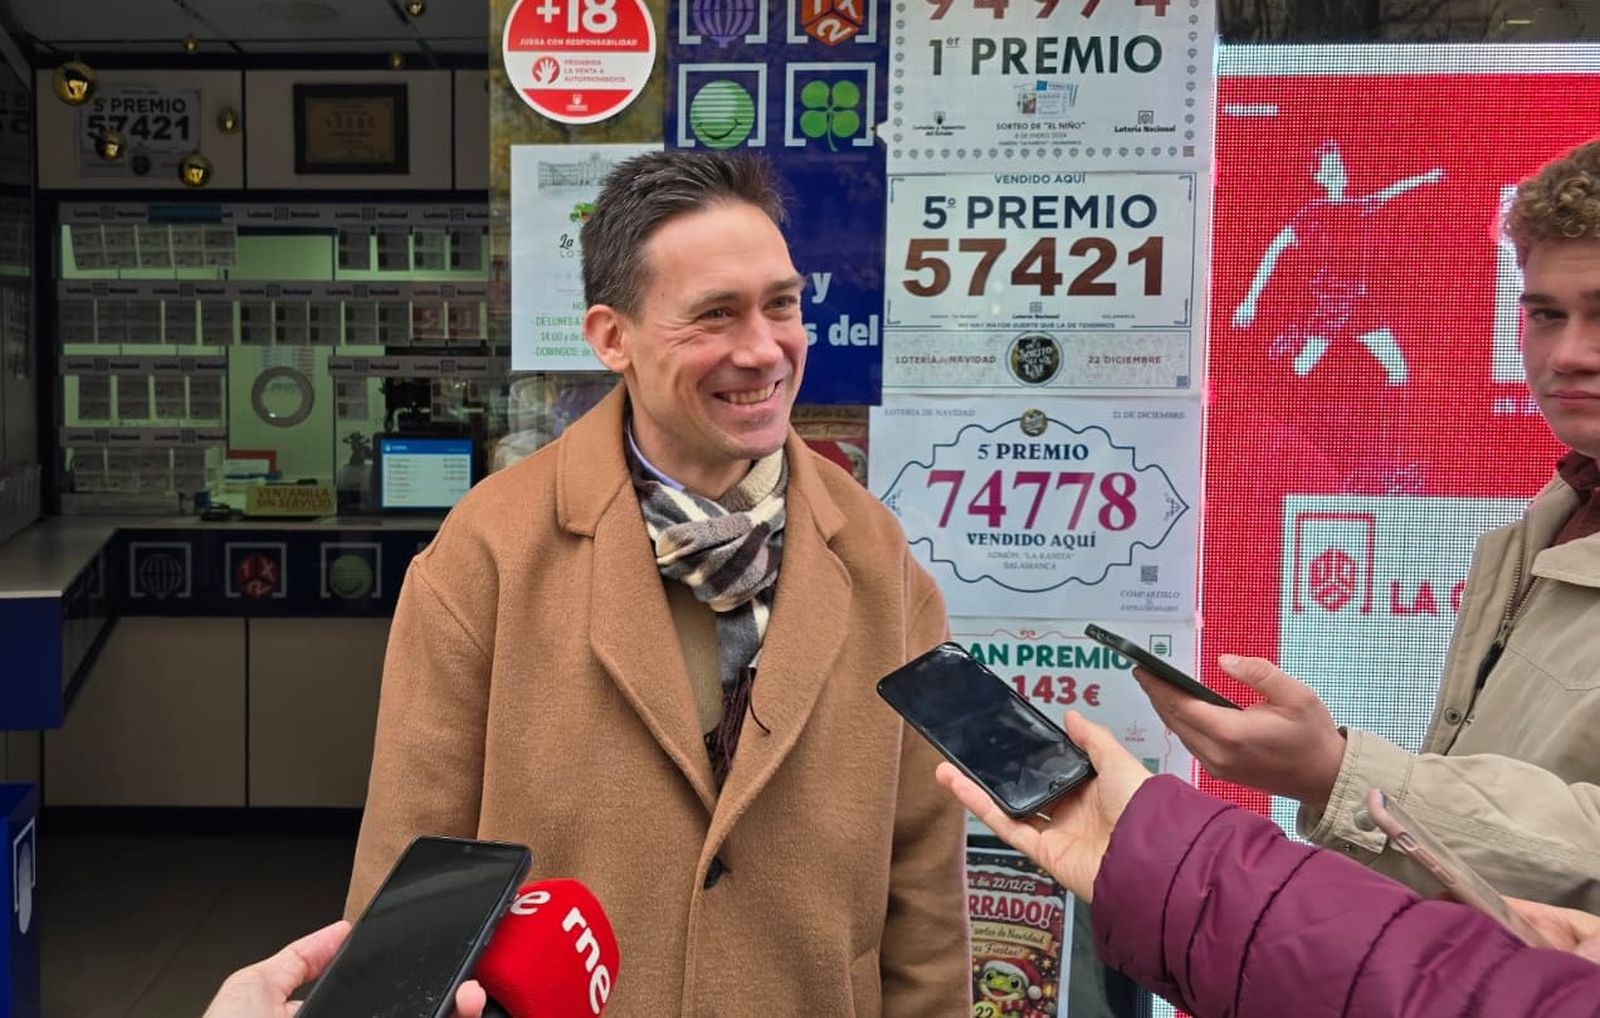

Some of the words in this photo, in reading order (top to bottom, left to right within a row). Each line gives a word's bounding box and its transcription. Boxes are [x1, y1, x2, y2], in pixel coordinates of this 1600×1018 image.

[536, 0, 619, 34] +18
[546, 38, 565, 46] CON
[971, 34, 1163, 76] PREMIO
[111, 98, 187, 114] PREMIO
[996, 122, 1029, 131] SORTEO
[995, 174, 1051, 184] VENDIDO
[1054, 172, 1087, 184] AQUÍ
[966, 194, 1158, 230] PREMIO
[559, 233, 574, 250] La
[902, 236, 1164, 298] 57421
[810, 272, 833, 304] y
[828, 314, 880, 346] del
[949, 355, 997, 365] NAVIDAD
[1103, 355, 1162, 365] DICIEMBRE
[976, 443, 990, 460] 5
[995, 442, 1090, 461] PREMIO
[256, 486, 331, 498] VENTANILLA
[925, 468, 1138, 532] 74778
[966, 531, 1046, 547] VENDIDO
[1049, 529, 1097, 552] AQUÍ
[1389, 579, 1438, 615] LA
[1082, 683, 1101, 707] €
[561, 906, 612, 1016] rne
